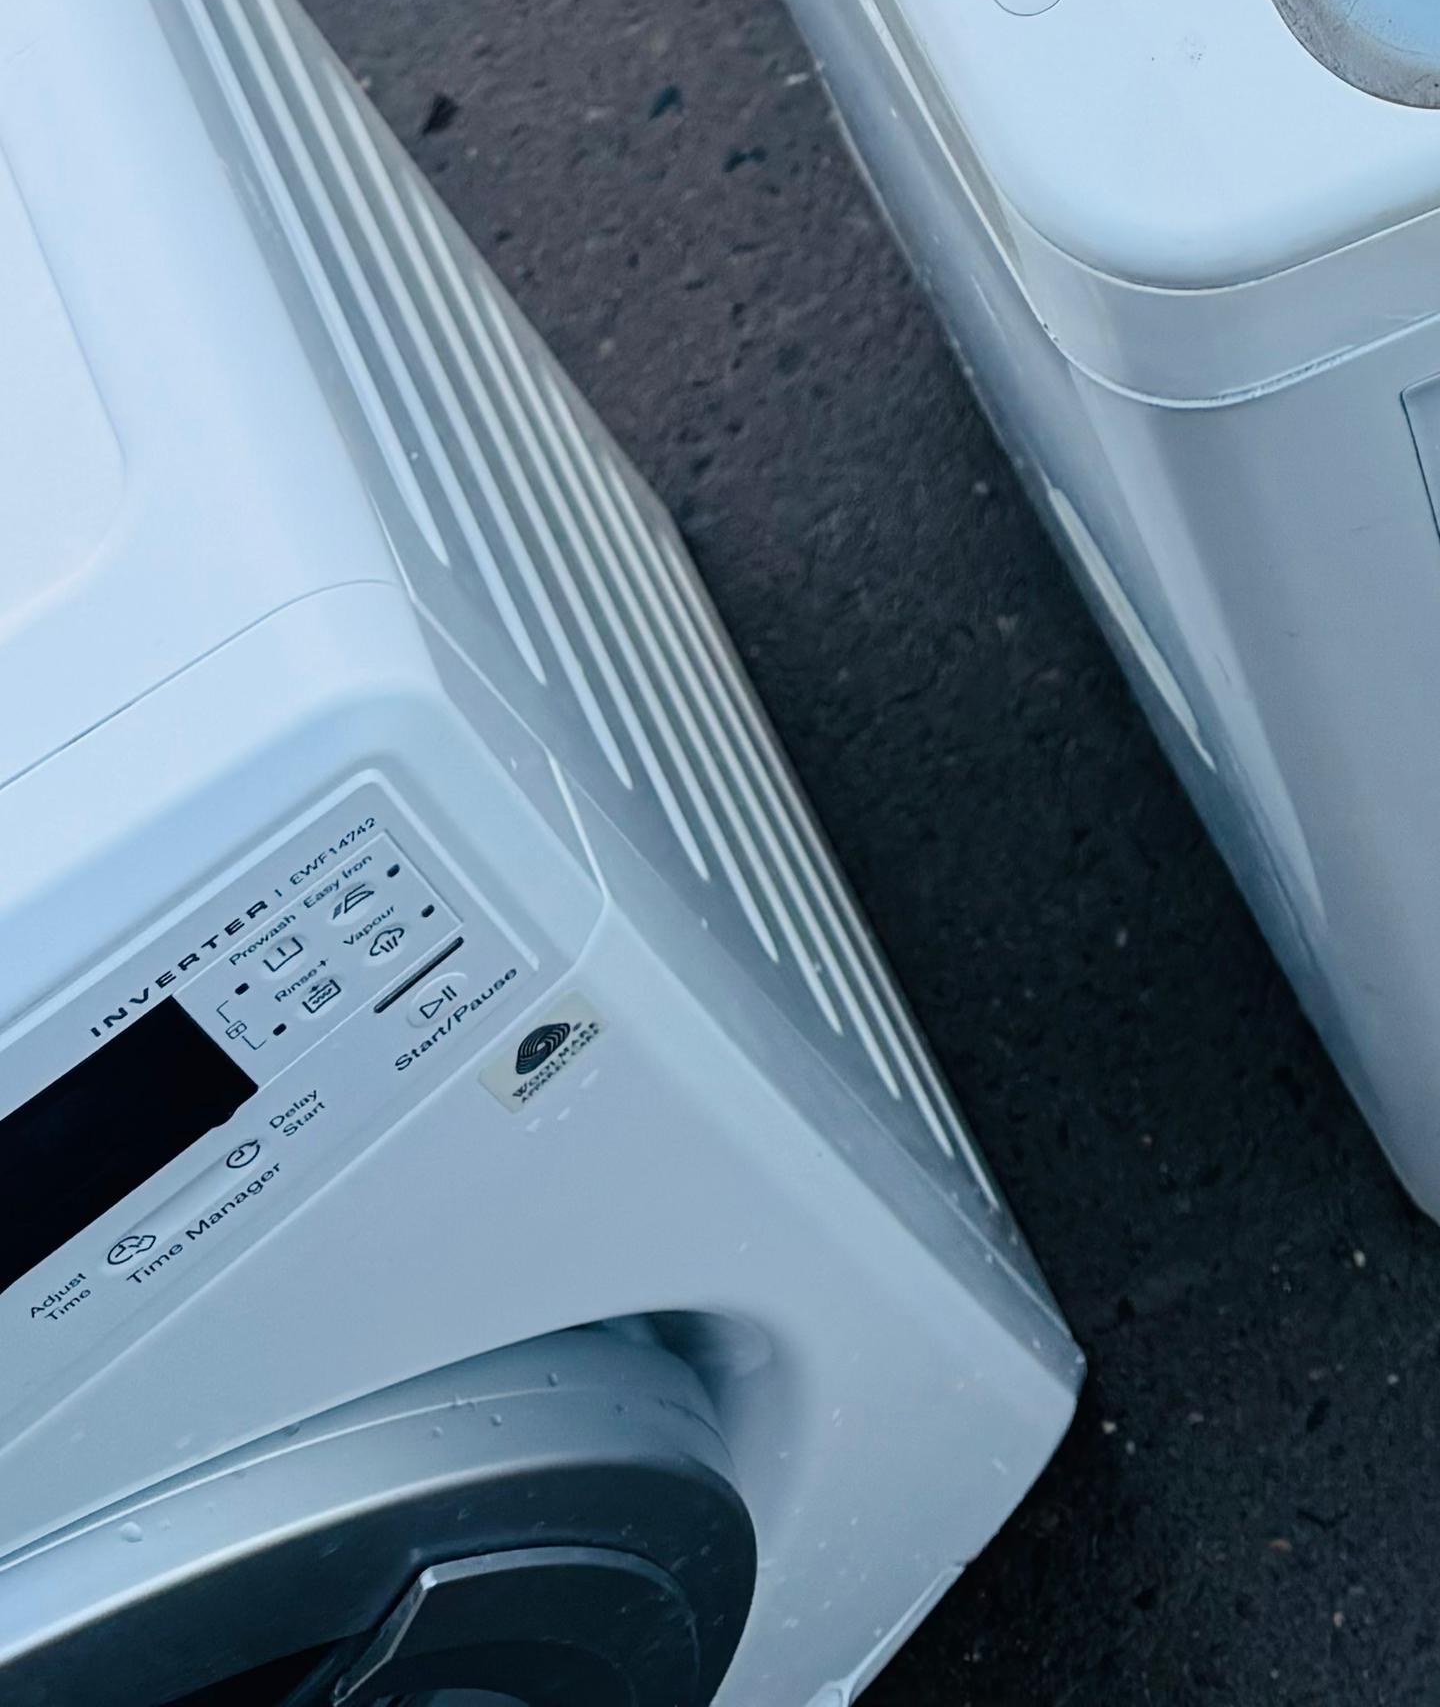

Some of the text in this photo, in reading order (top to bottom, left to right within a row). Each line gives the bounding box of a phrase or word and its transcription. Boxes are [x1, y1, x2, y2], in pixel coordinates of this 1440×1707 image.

[303, 855, 373, 908] Easy Iron
[90, 899, 268, 1038] INVERTER
[290, 817, 376, 886] EWF14742
[343, 905, 395, 946] Vapour
[394, 968, 518, 1072] Start/Pause
[268, 1089, 318, 1129] Delay
[283, 1101, 326, 1137] Start
[127, 1162, 281, 1285] Time Manager
[30, 1272, 87, 1319] Adjust
[44, 1289, 92, 1322] Time
